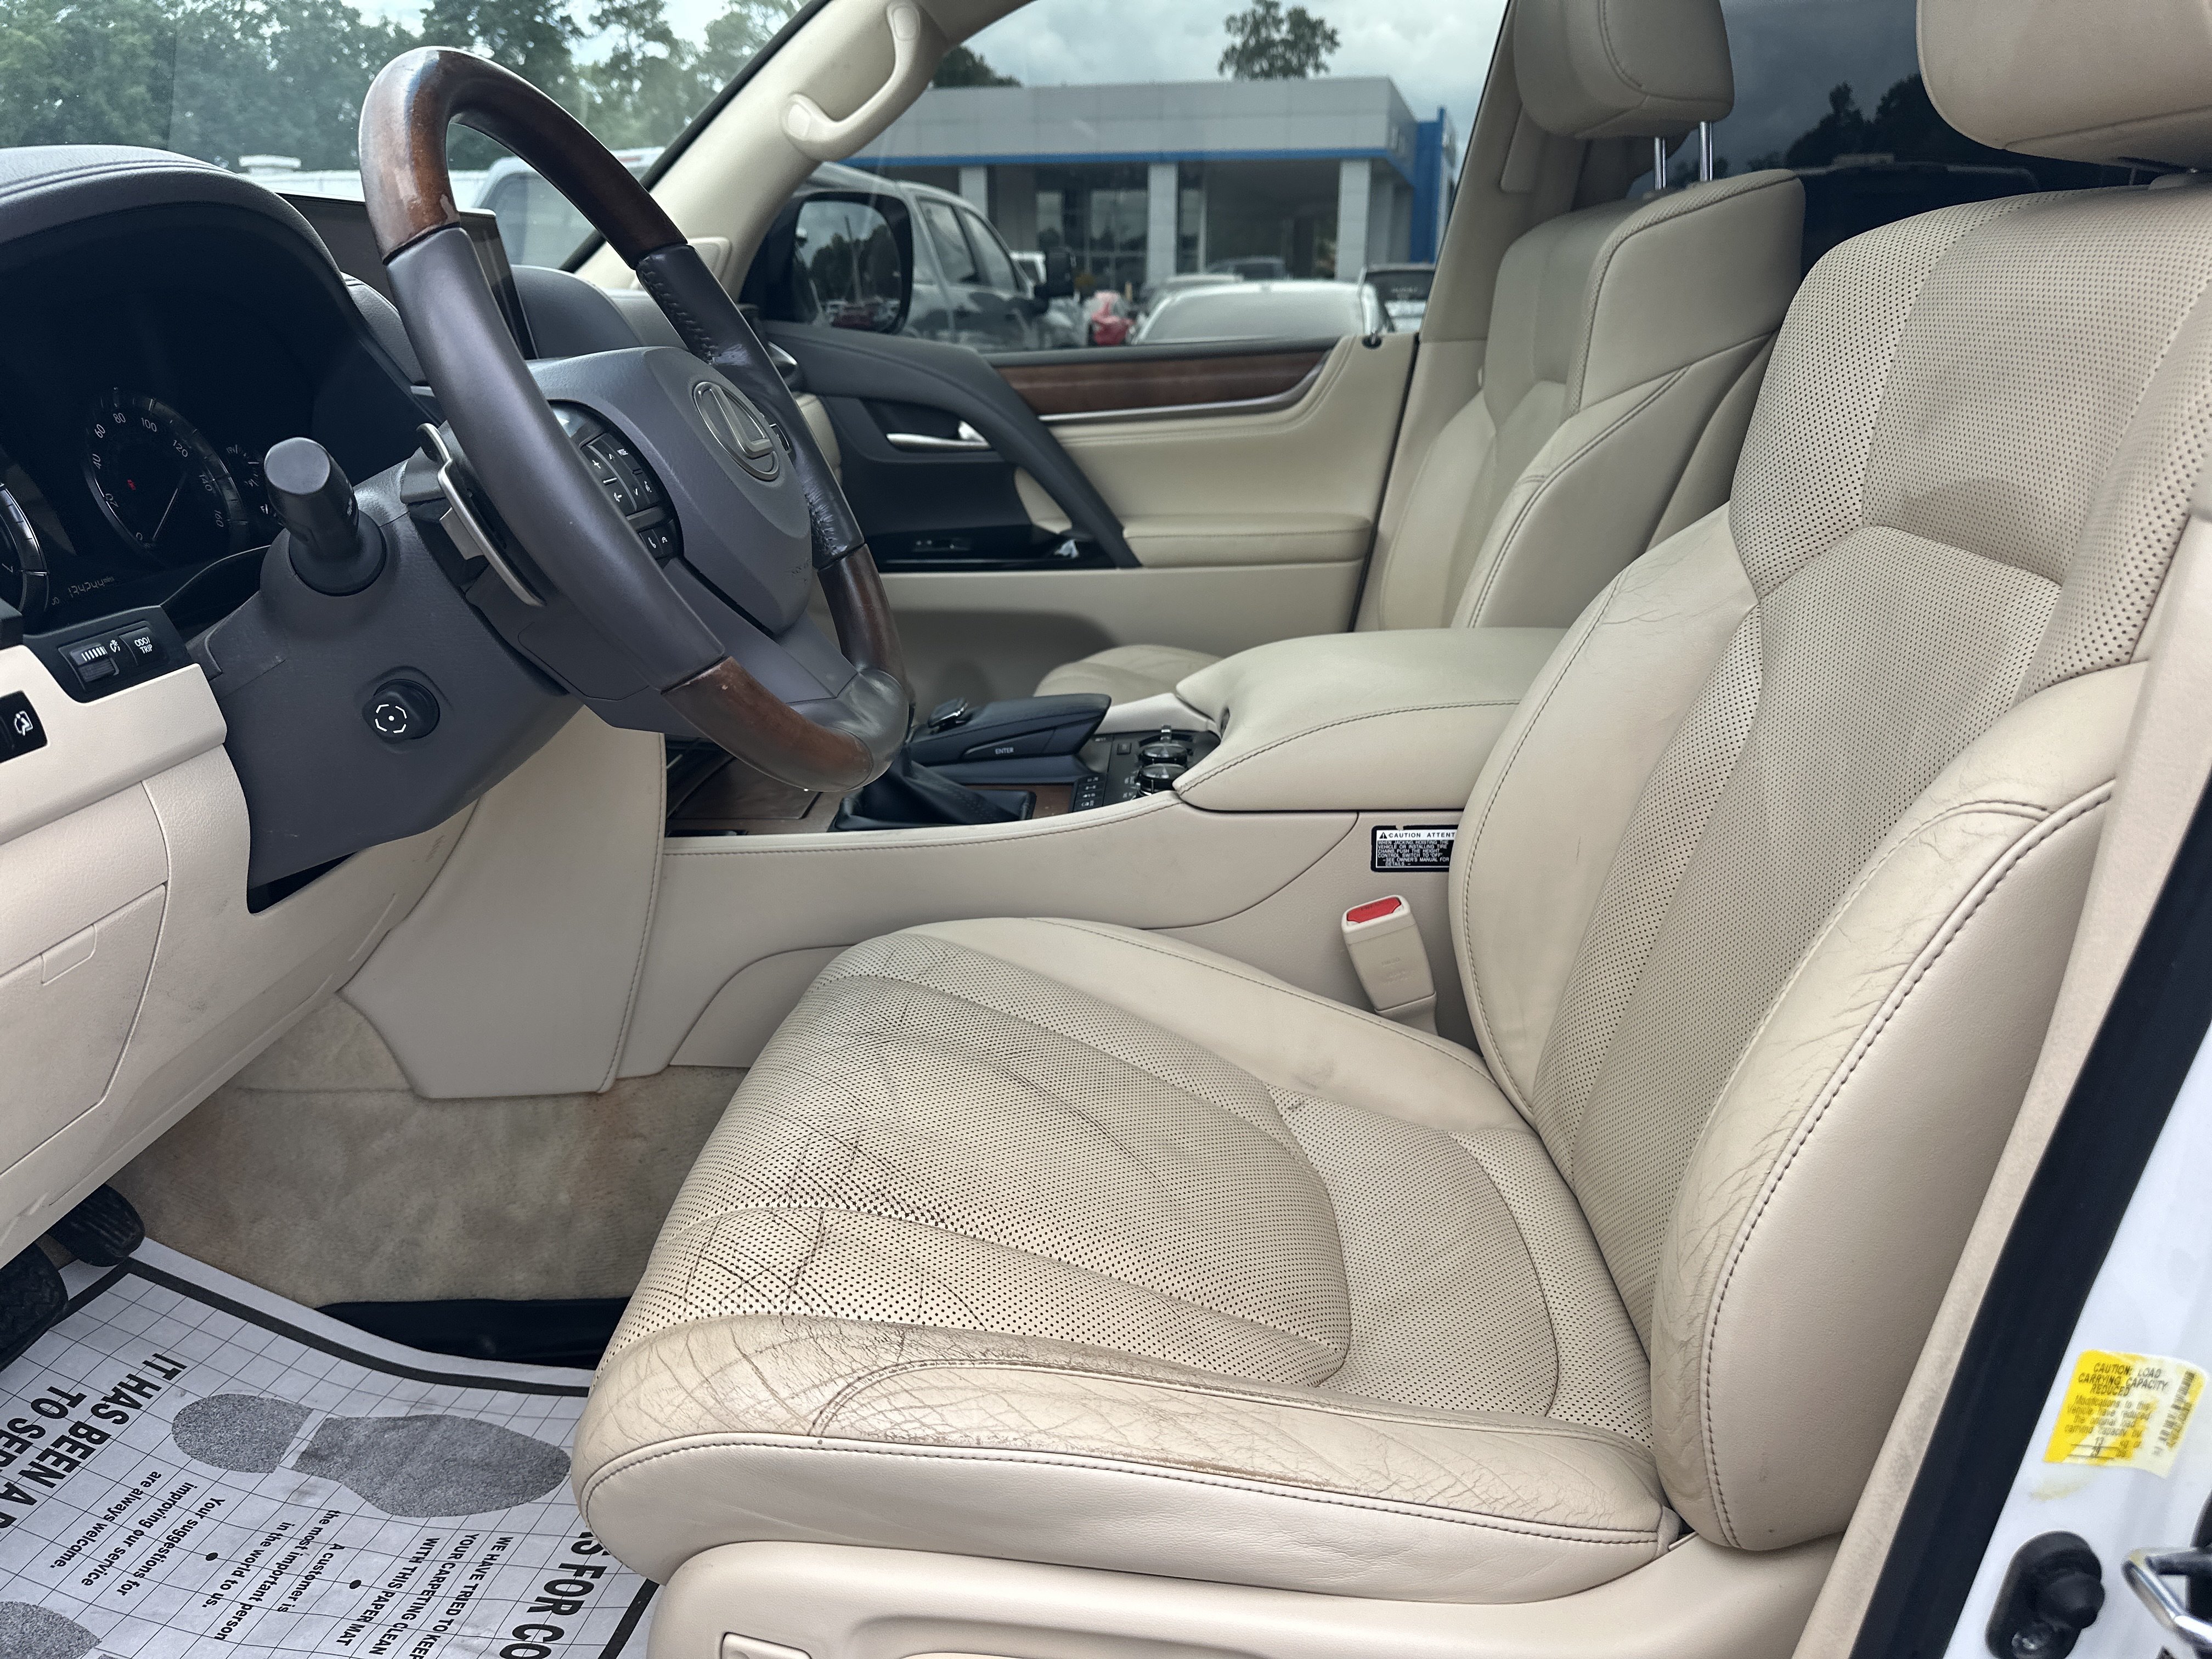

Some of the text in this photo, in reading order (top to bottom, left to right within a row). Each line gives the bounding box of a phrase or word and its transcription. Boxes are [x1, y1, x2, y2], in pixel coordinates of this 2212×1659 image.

[113, 413, 126, 424] 80
[141, 417, 157, 432] 100
[94, 424, 105, 438] 60
[173, 440, 188, 458] 120
[92, 454, 101, 470] 40
[199, 474, 212, 491] 140
[214, 510, 224, 527] 160
[139, 644, 153, 654] TRIP
[2078, 1372, 2169, 1391] CARRYING CAPACITY
[2138, 1367, 2162, 1379] LOAD
[2089, 1383, 2131, 1396] REDUCED
[31, 1386, 87, 1419] TO
[0, 1353, 188, 1505] IT HAS BEEN A
[50, 1471, 161, 1568] are always welcome.
[82, 1482, 198, 1585] improving our service
[117, 1497, 225, 1596] Your suggestions for
[490, 1537, 514, 1551] WE
[201, 1522, 296, 1608] in the world to us.
[469, 1554, 500, 1581] HAVE
[214, 1510, 341, 1640] the most important person
[287, 1552, 334, 1601] customer
[336, 1538, 440, 1646] WITH THIS PAPER MAT
[369, 1533, 479, 1655] YOUR CARPETING CLEAN
[527, 1562, 607, 1616] FOR
[277, 1602, 296, 1612] is
[445, 1583, 479, 1616] TRIED
[432, 1618, 454, 1632] TO
